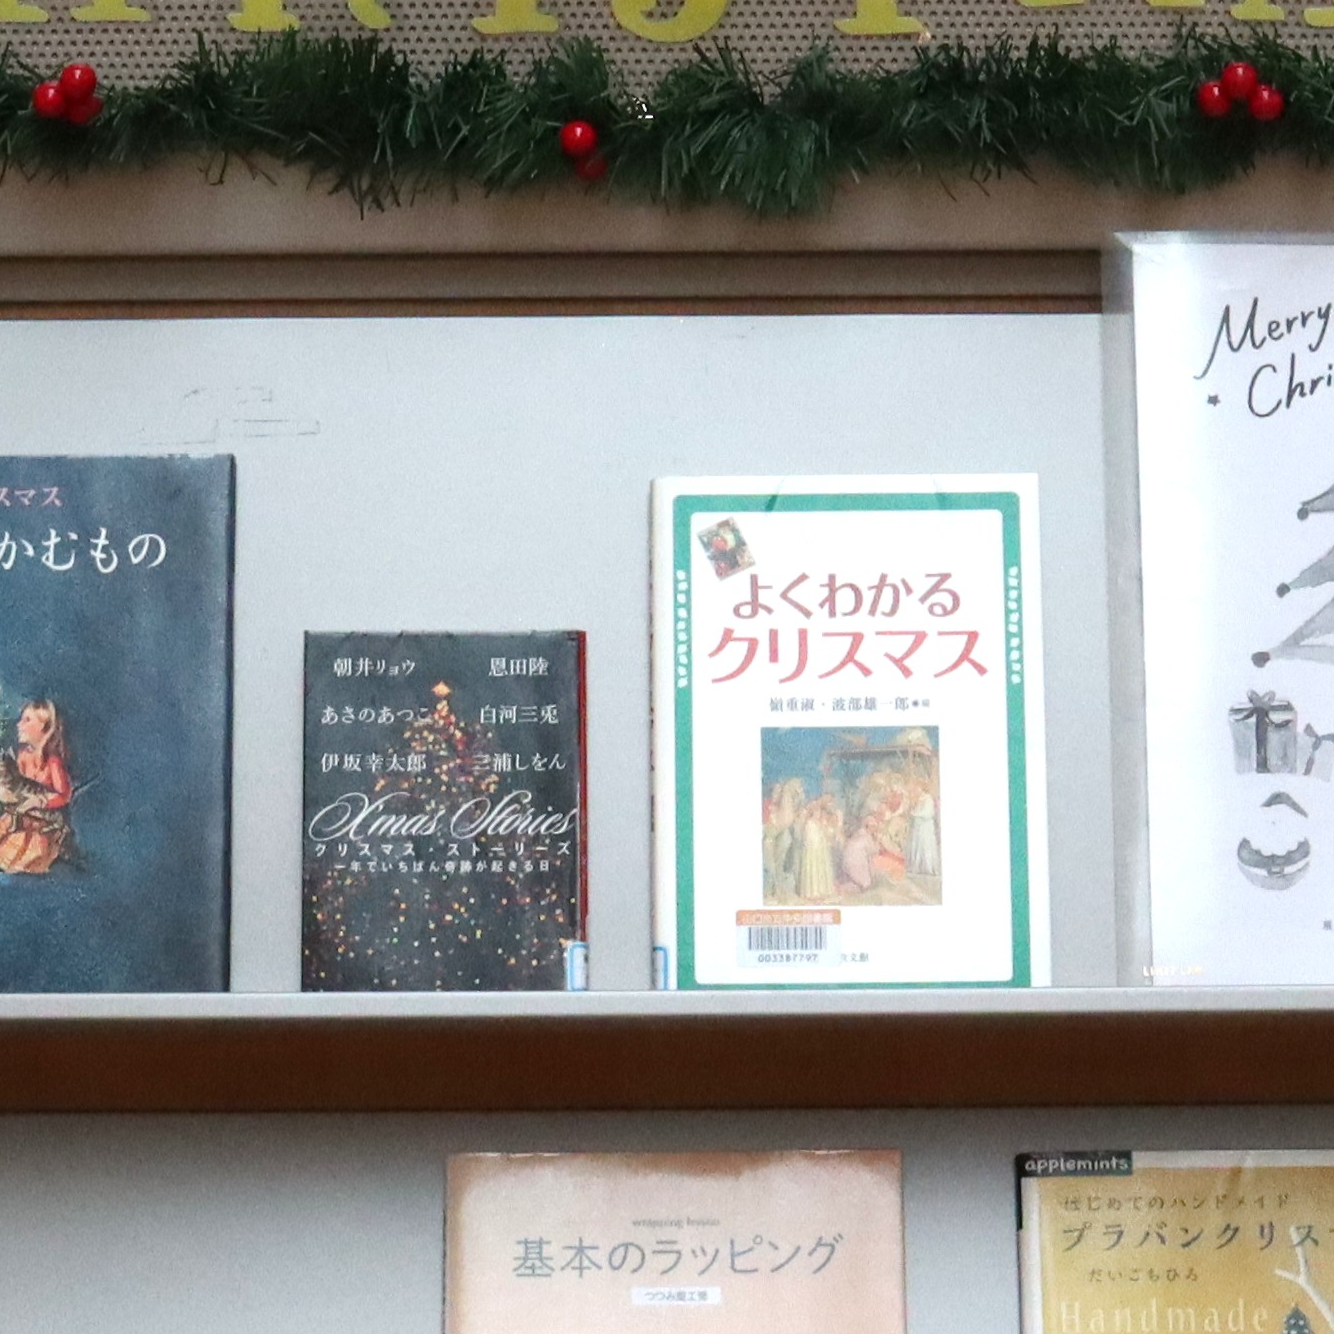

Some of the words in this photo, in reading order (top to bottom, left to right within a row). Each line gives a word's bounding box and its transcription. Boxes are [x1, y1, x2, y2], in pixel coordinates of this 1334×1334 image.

[1194, 296, 1334, 379] Merry
[731, 571, 962, 620] よくわかる
[333, 657, 416, 678] 朝井リョウ
[488, 656, 550, 678] 恩田陸
[707, 627, 989, 685] クリスマス
[320, 705, 434, 725] あさのあつこ
[320, 752, 428, 773] 伊坂幸太郎
[471, 752, 567, 772] 三浦しをん
[450, 789, 581, 840] Stories
[314, 841, 572, 859] クリスマス・ストーリーズ
[1024, 1155, 1130, 1173] applemints
[512, 1232, 845, 1280] 基本のラッピング
[1059, 1297, 1269, 1334] Handmade
